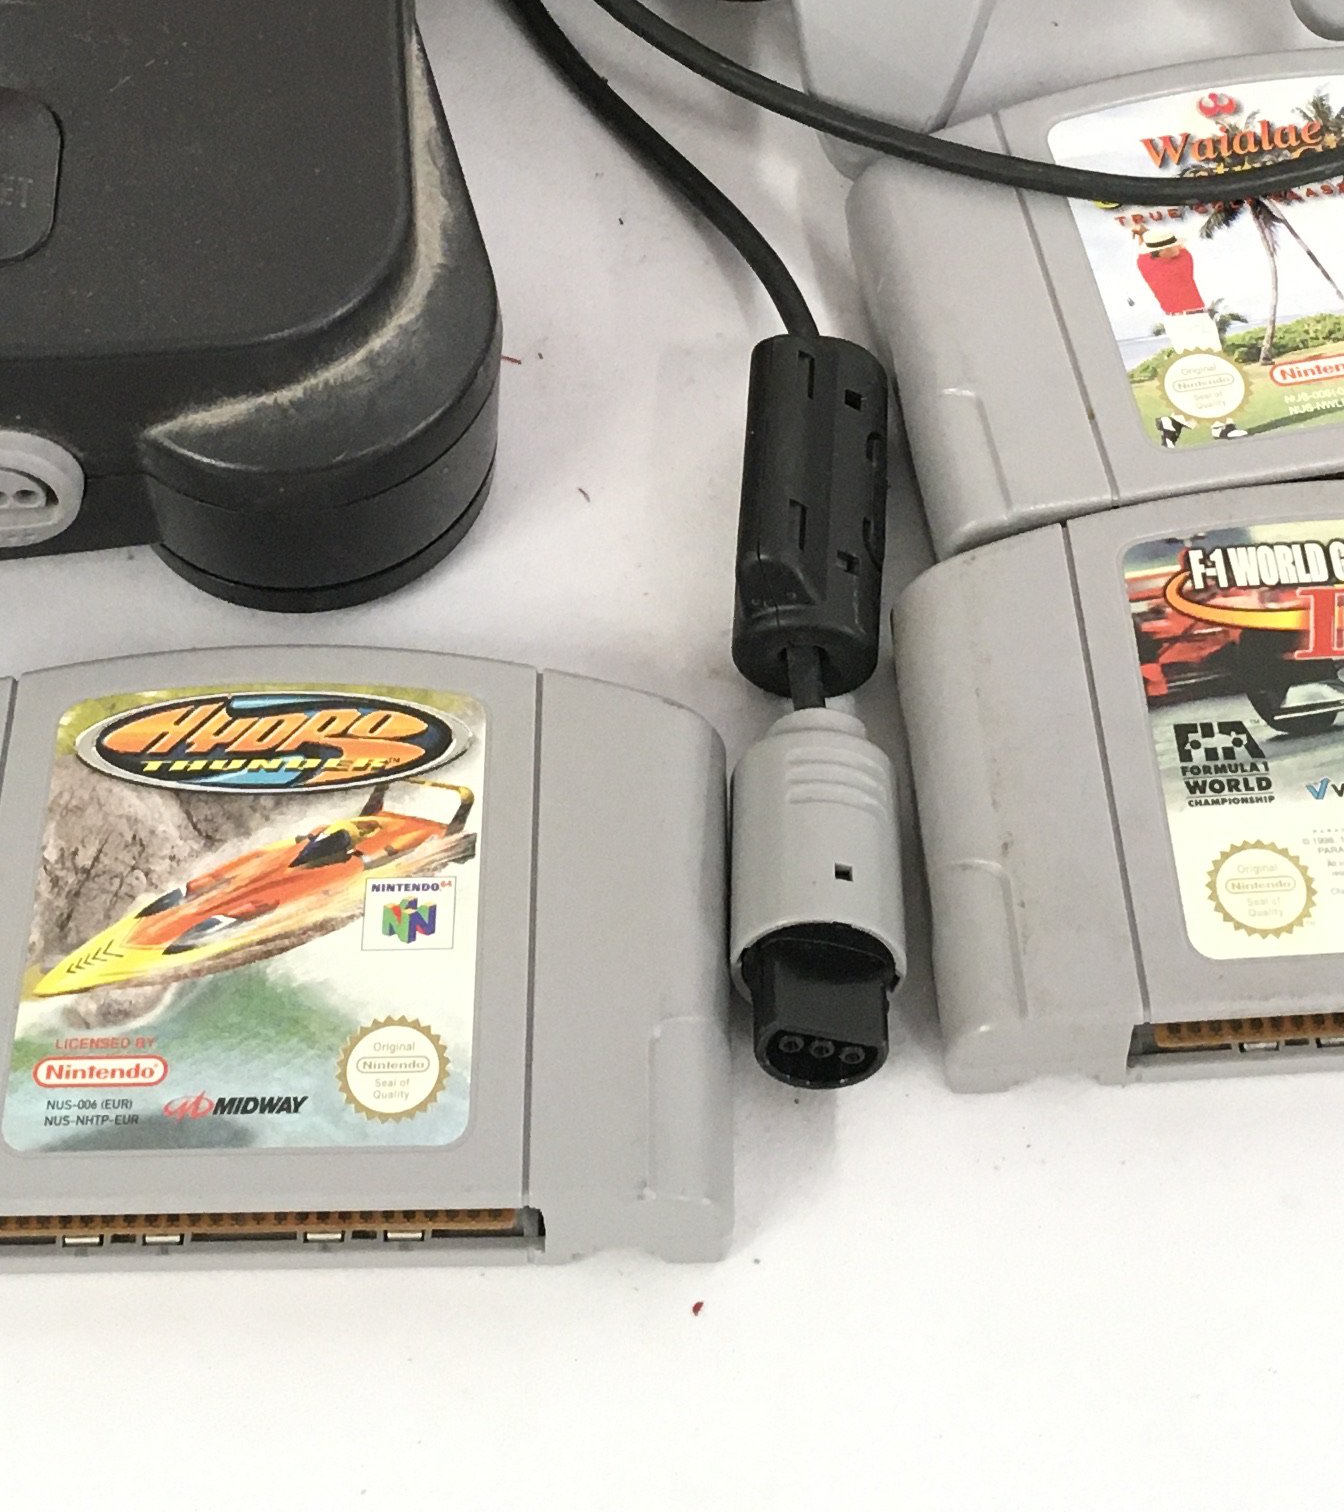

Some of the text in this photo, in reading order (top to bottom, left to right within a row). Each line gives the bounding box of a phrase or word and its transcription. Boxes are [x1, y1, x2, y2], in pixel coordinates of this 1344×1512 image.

[1141, 119, 1324, 168] Waialae
[1115, 208, 1182, 227] TRUE
[1227, 540, 1334, 586] WORLD
[140, 754, 390, 774] THUNDER
[1180, 763, 1258, 777] FORMULA
[1184, 776, 1273, 796] WORLD
[1187, 795, 1275, 808] CHAMPIONSHIP
[1237, 863, 1278, 874] Original
[1231, 879, 1292, 890] Nintendo
[56, 1037, 155, 1050] LICENSED BY
[373, 1041, 416, 1055] Original
[362, 1059, 424, 1070] Nintendo
[45, 1063, 156, 1080] Nintendo
[374, 1077, 410, 1088] Seal of
[373, 1089, 410, 1101] Quality
[46, 1098, 134, 1111] NUS-006 (EUR)
[213, 1095, 309, 1116] MIDWAY
[44, 1114, 139, 1127] NUS-NHTP-EUR
